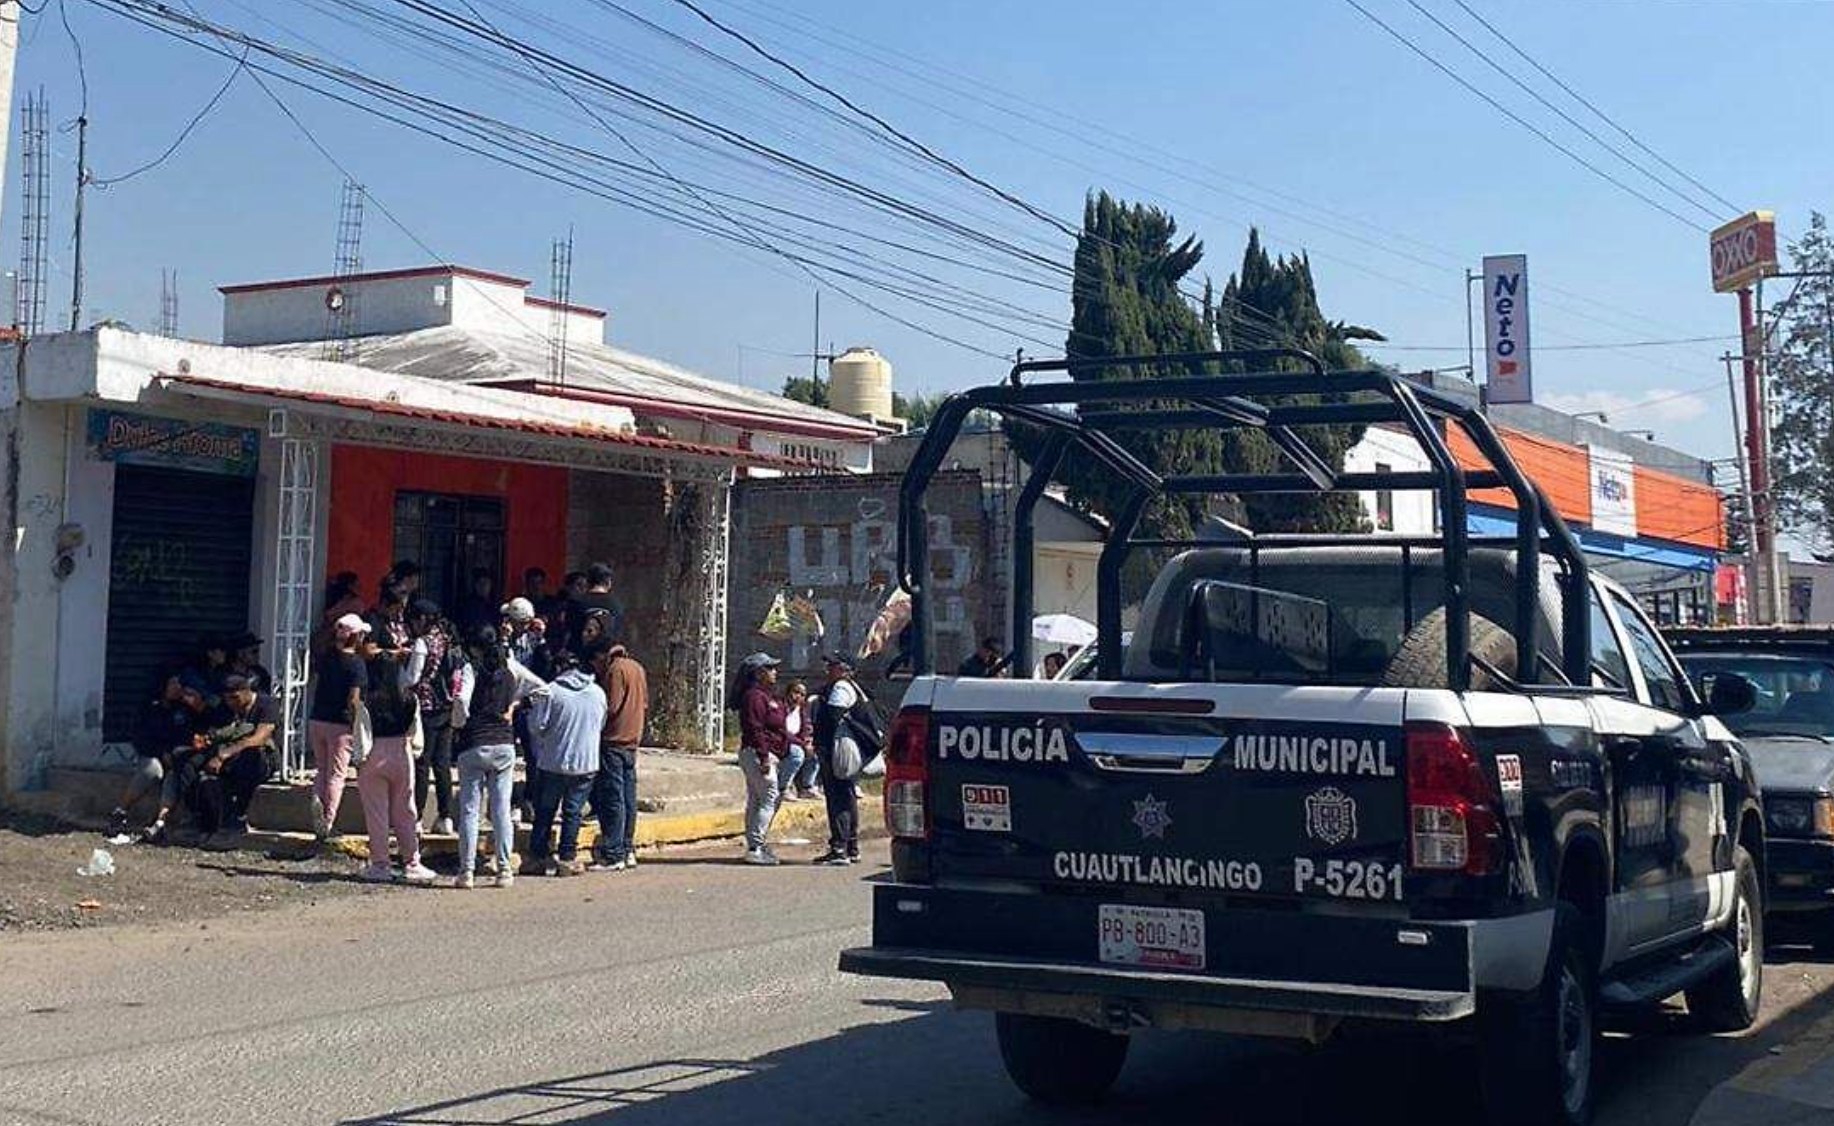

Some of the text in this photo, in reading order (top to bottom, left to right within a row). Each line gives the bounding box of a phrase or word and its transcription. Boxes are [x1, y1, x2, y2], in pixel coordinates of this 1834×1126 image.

[1713, 227, 1757, 277] OXXO
[1493, 273, 1519, 356] Neto
[939, 718, 1069, 763] POLICÍA
[1234, 734, 1396, 777] MUNICIPAL
[963, 786, 1004, 803] 911
[1293, 857, 1404, 902] P-5261
